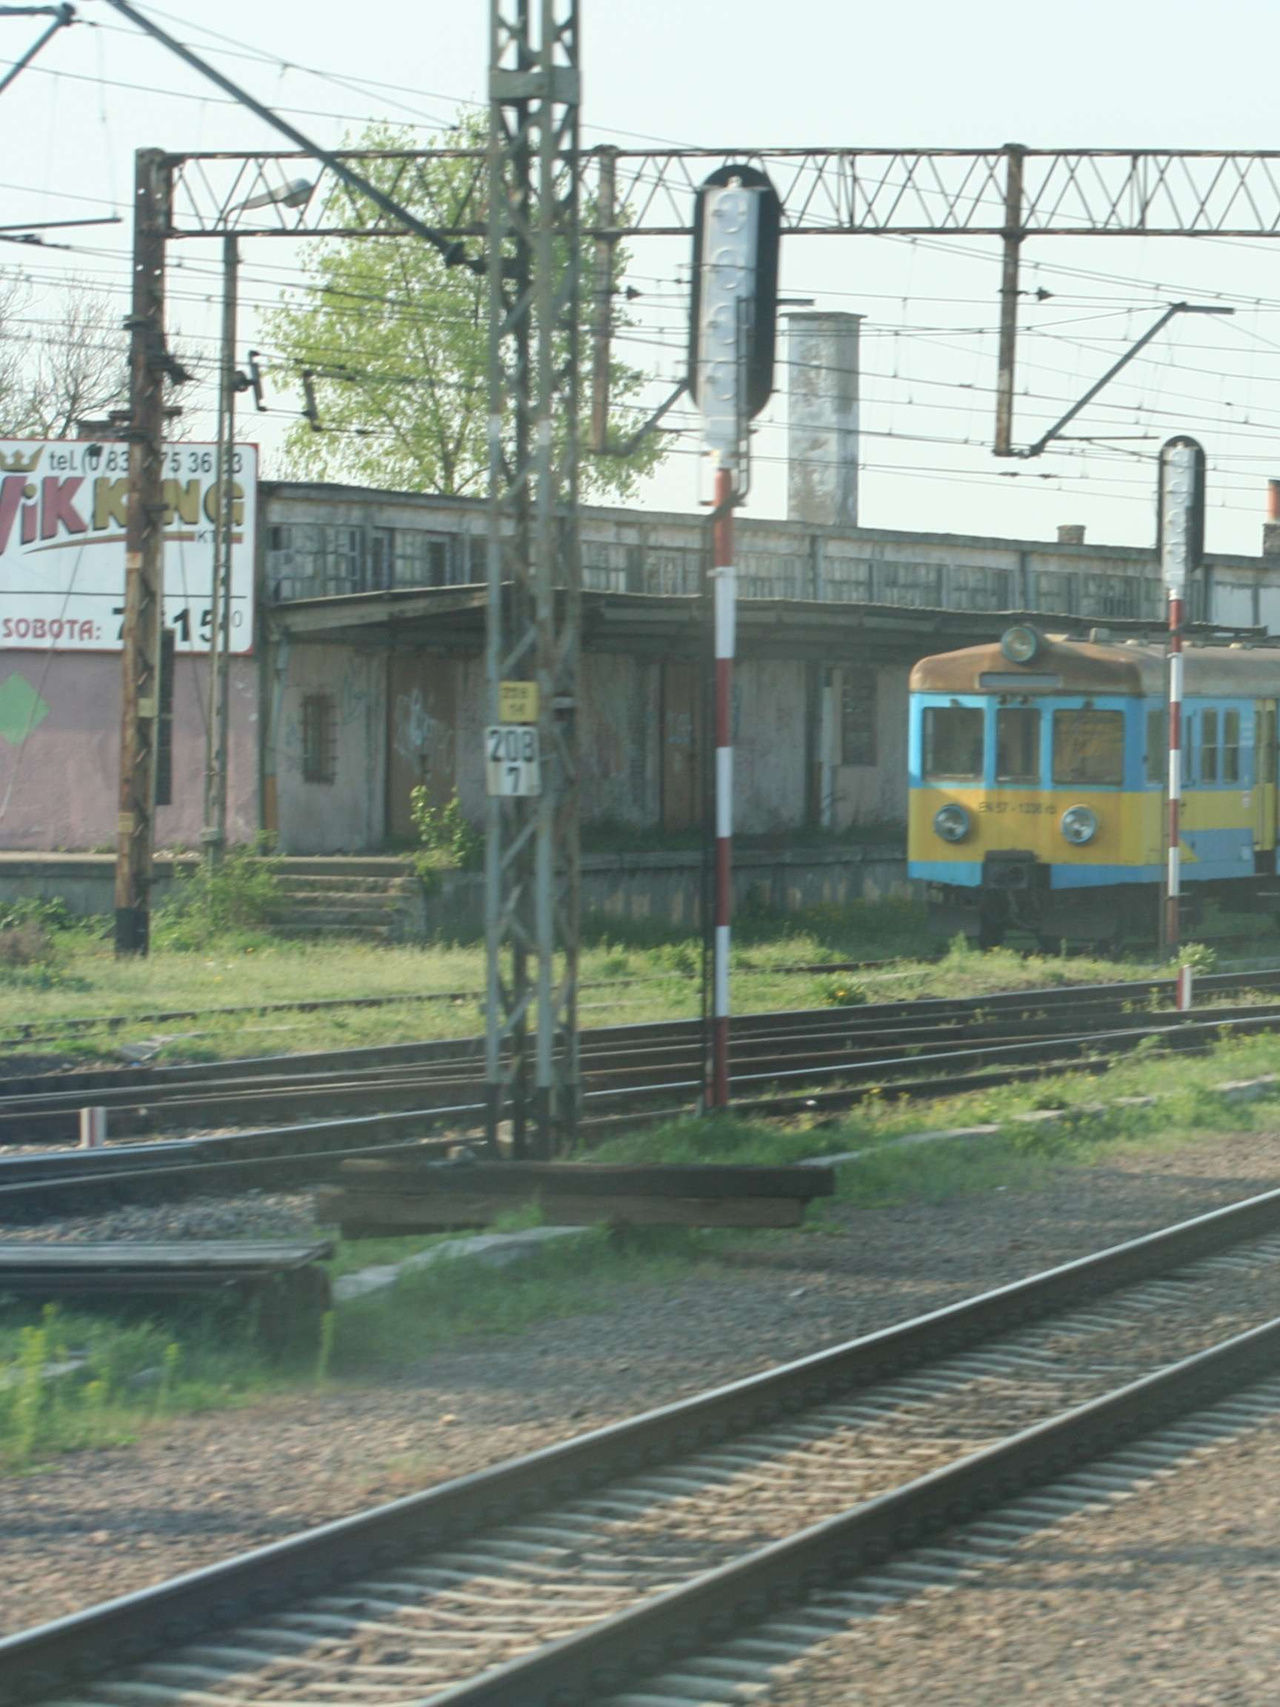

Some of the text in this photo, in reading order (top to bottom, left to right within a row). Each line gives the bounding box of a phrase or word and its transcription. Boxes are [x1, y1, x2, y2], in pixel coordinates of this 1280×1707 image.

[188, 452, 213, 474] 36
[92, 476, 245, 528] KNG
[2, 618, 102, 641] SOBOTA:
[507, 766, 520, 794] 7
